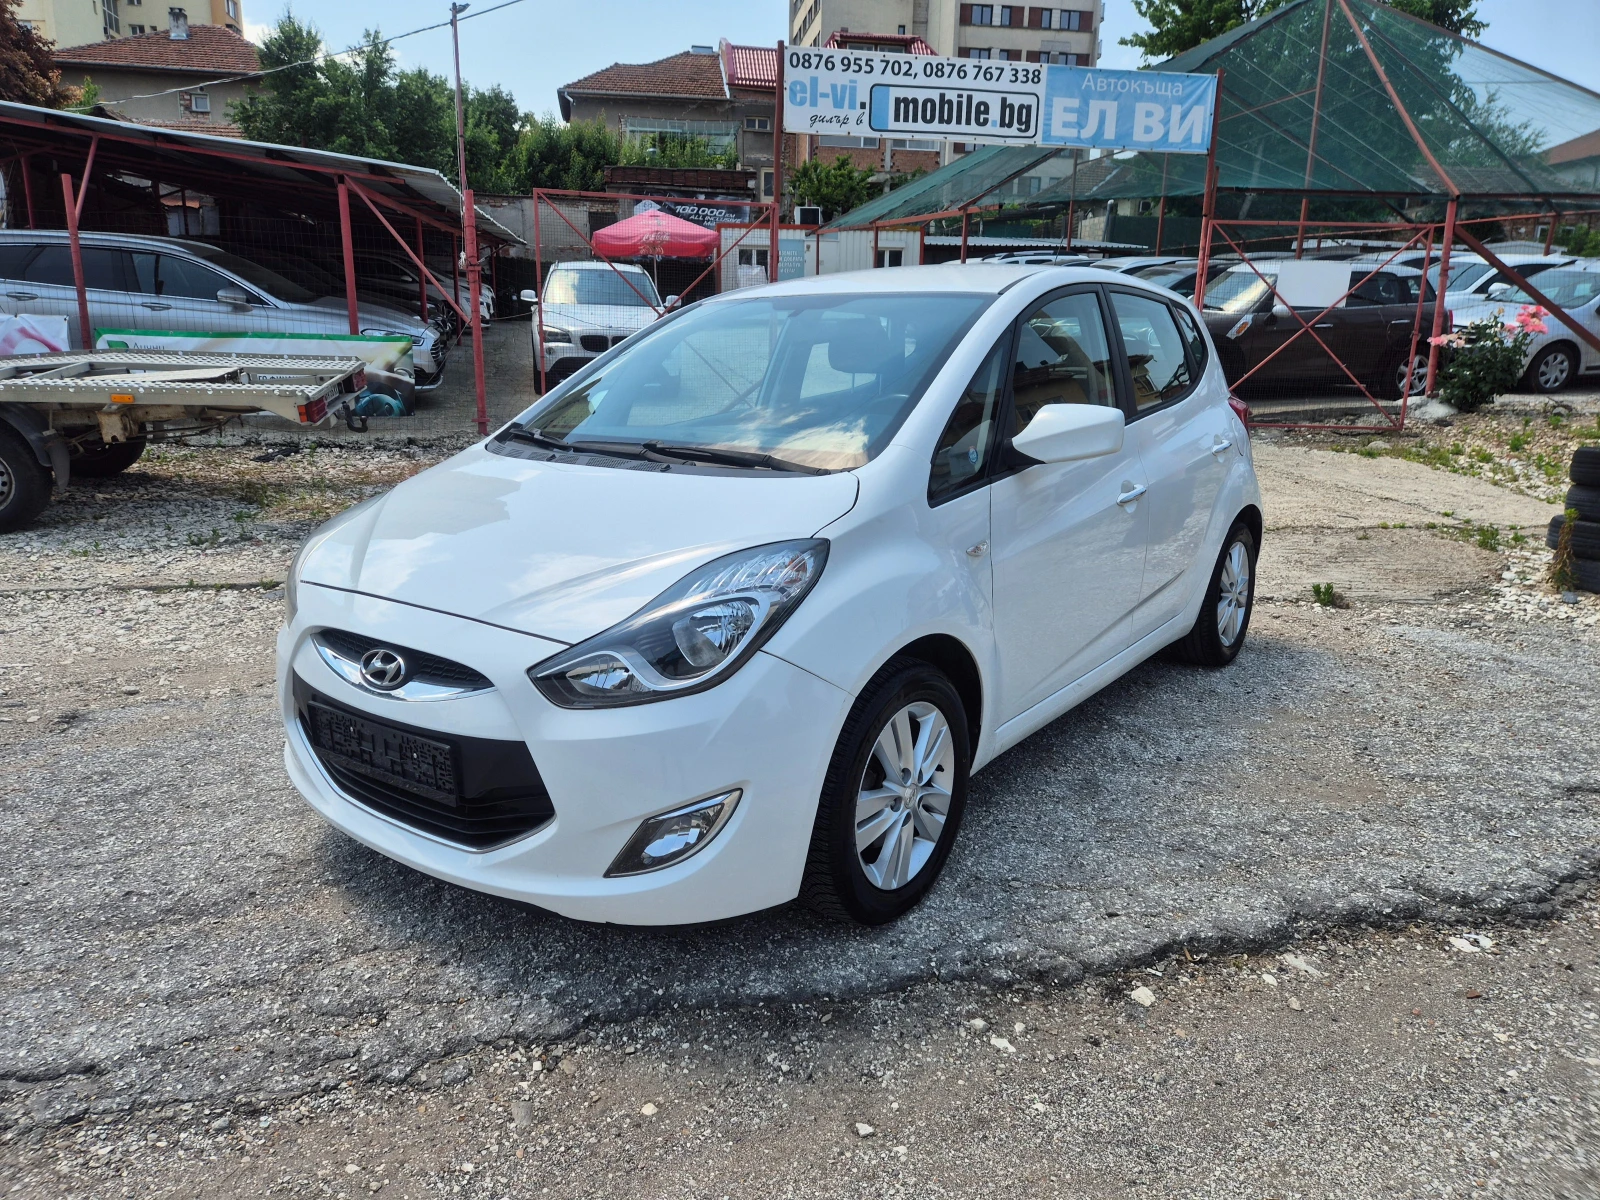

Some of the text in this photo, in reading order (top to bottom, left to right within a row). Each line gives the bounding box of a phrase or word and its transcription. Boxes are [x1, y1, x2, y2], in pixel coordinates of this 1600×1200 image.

[789, 52, 1042, 85] 0876 955 702, 0876 767 338
[1081, 72, 1183, 98] Автокъща
[893, 92, 1033, 133] mobile.bg
[1050, 96, 1206, 144] ЕЛ ВИ
[704, 215, 742, 224] INCLUSIVE
